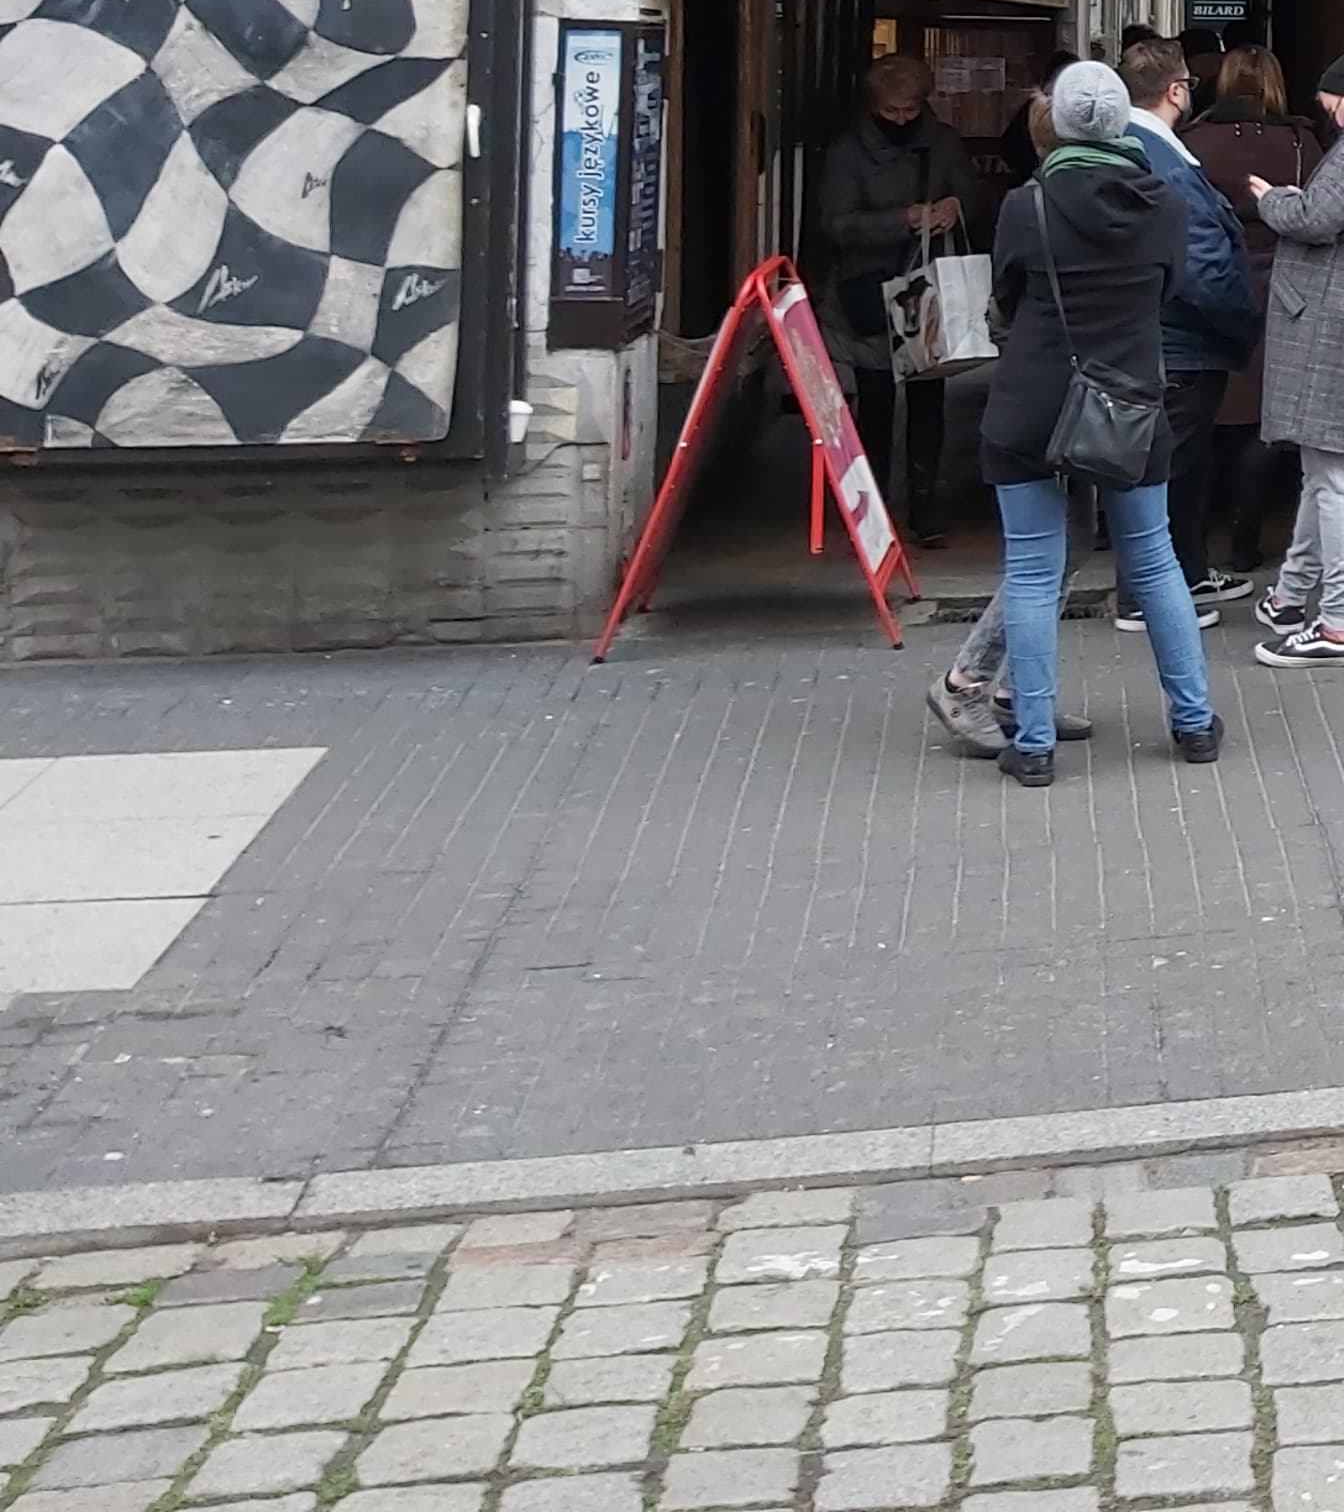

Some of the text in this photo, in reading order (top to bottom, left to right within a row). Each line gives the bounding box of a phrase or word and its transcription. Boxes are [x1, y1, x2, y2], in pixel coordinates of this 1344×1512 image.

[1192, 4, 1245, 17] BILARD
[577, 71, 605, 181] językowe
[575, 183, 604, 242] kursy
